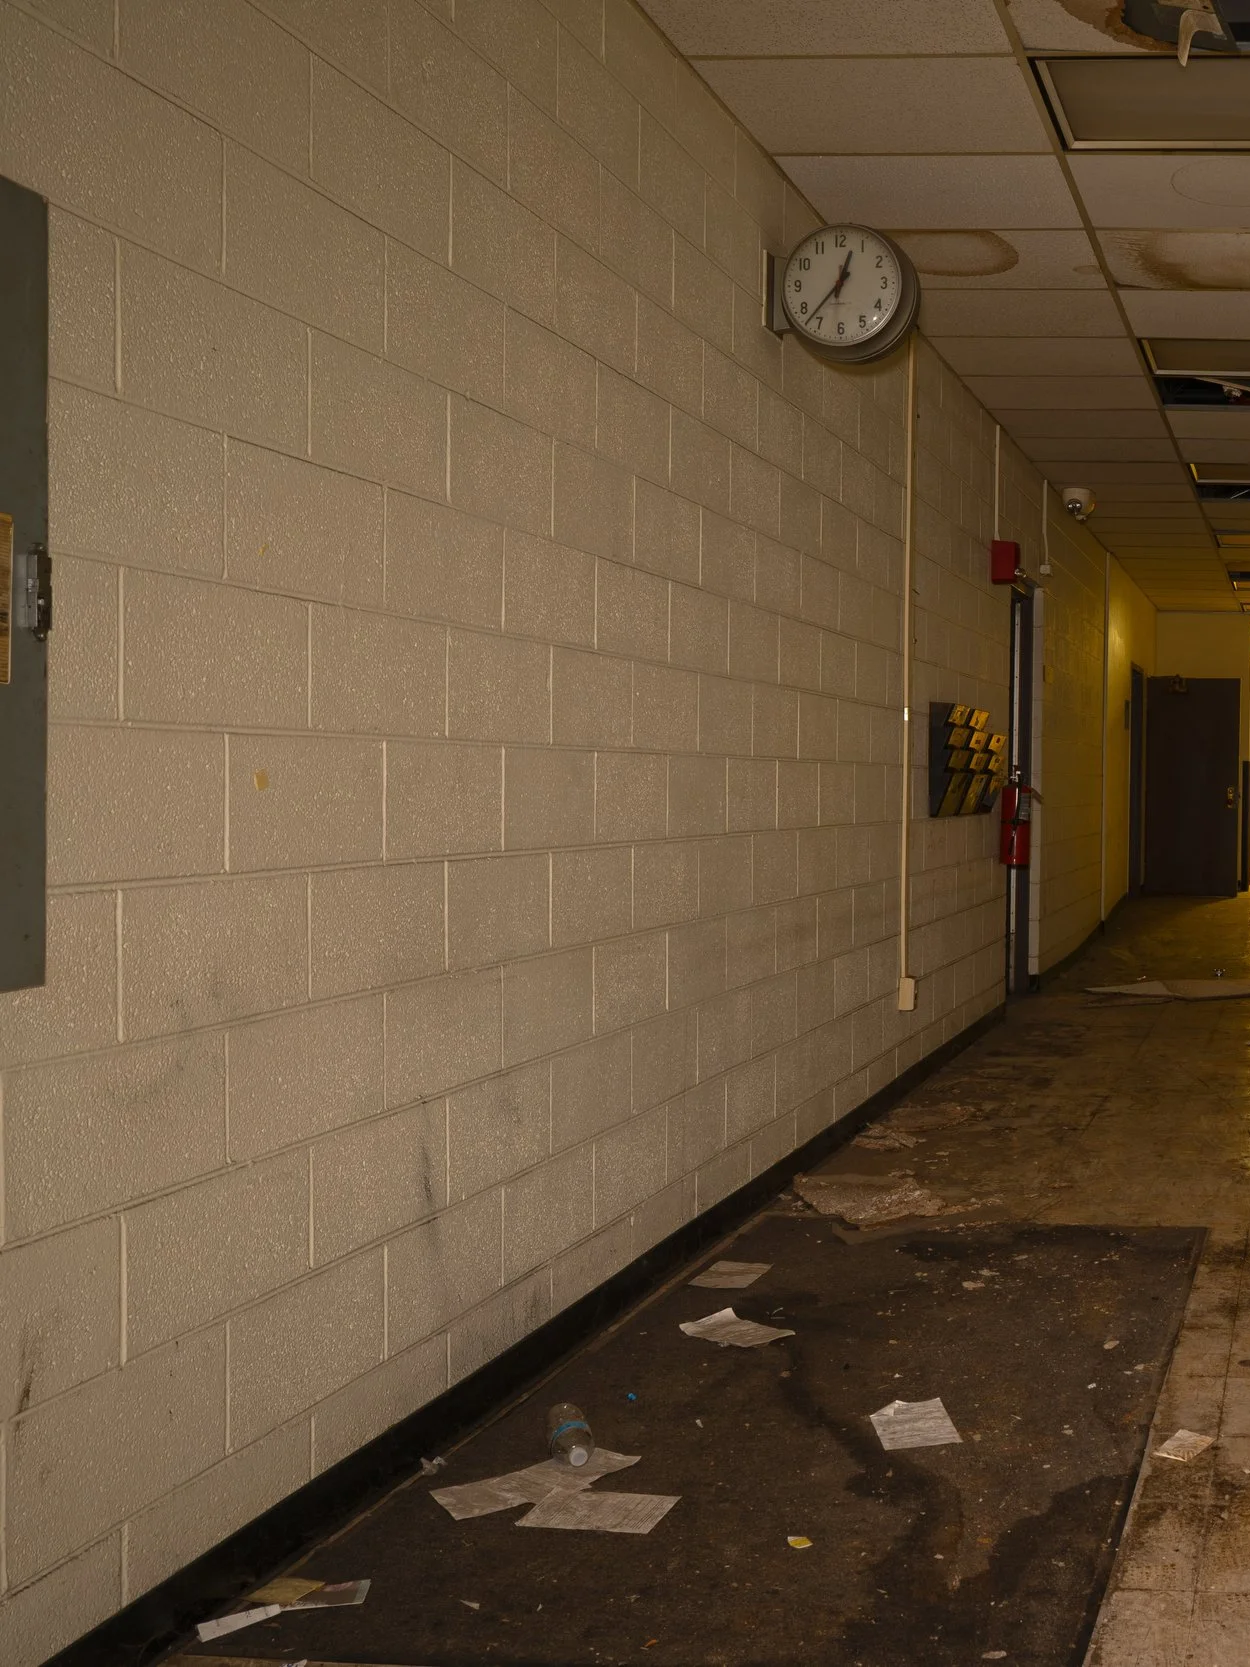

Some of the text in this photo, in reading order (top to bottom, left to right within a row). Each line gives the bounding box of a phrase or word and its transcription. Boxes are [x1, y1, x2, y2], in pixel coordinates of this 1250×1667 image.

[815, 241, 825, 254] 11
[835, 234, 848, 248] 12
[798, 258, 811, 271] 10
[875, 255, 883, 269] 2
[794, 280, 802, 293] 9
[880, 276, 888, 290] 3
[800, 302, 808, 315] 8
[874, 298, 882, 311] 4
[815, 316, 824, 330] 7
[837, 322, 845, 335] 6
[858, 315, 867, 329] 5
